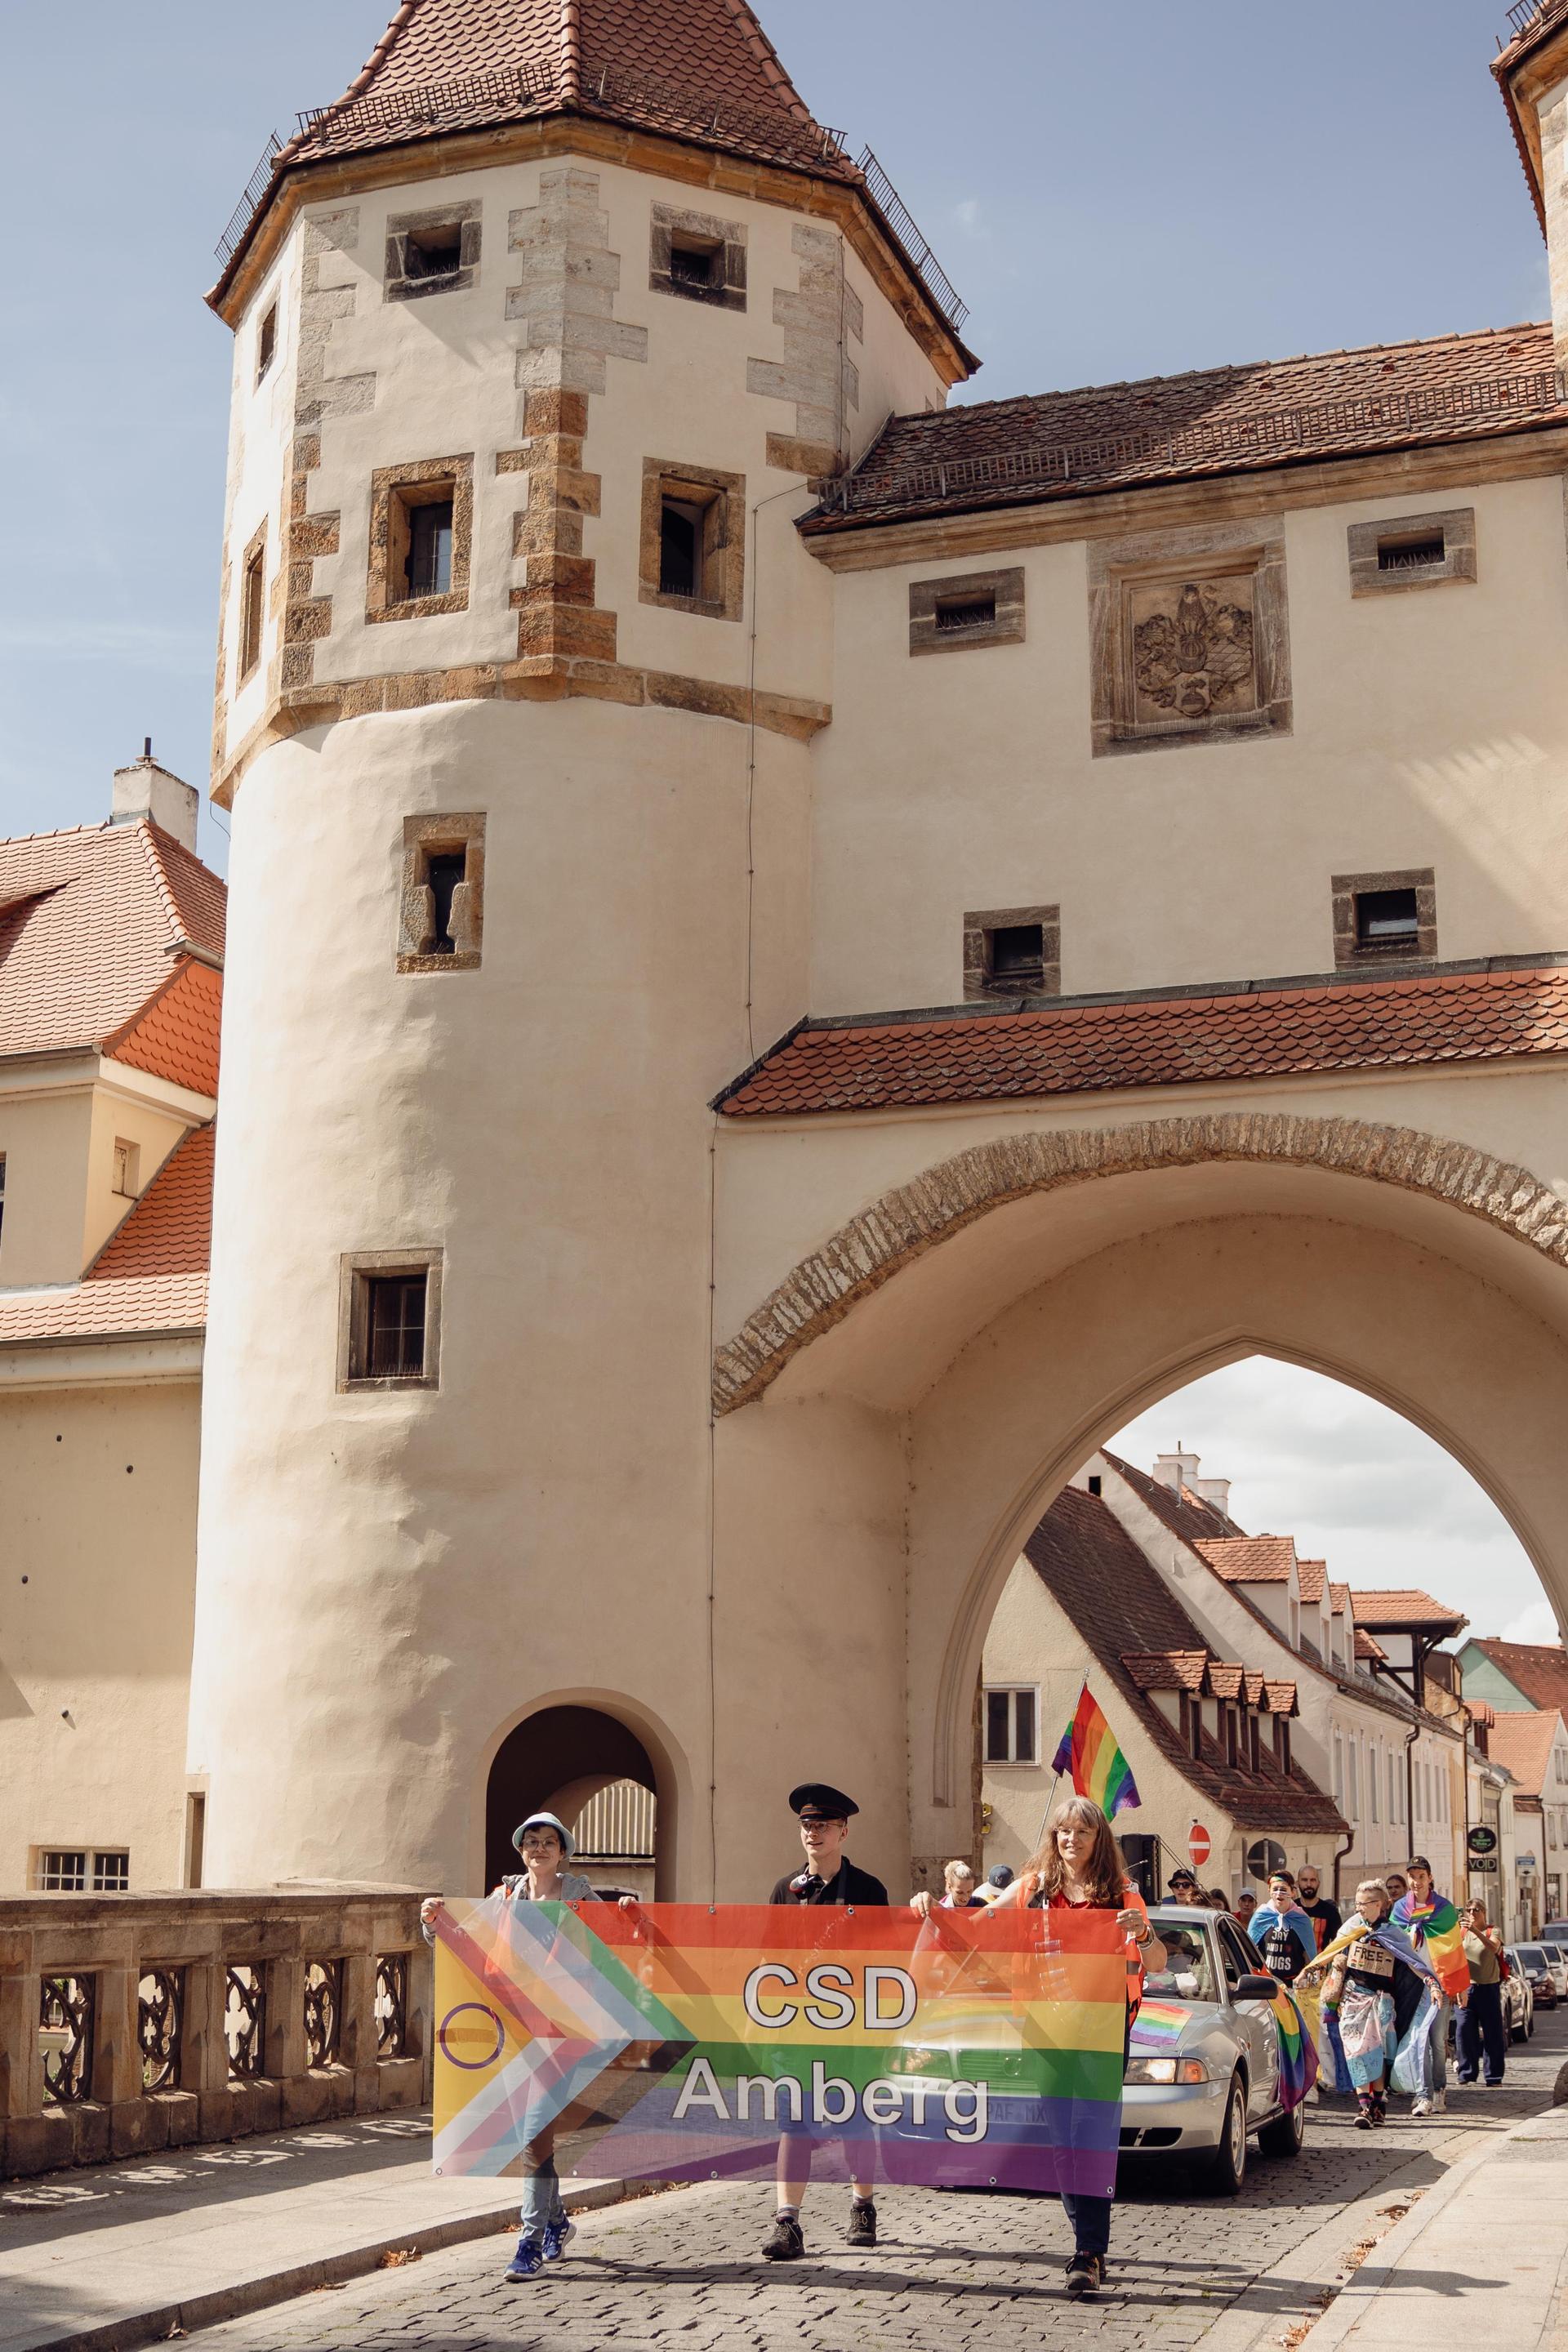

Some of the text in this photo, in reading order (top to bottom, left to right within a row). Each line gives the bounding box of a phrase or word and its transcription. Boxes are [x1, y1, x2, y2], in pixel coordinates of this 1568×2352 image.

[1469, 1859, 1496, 1870] VOID
[743, 1963, 918, 2030] CSD
[672, 2056, 990, 2144] Amberg
